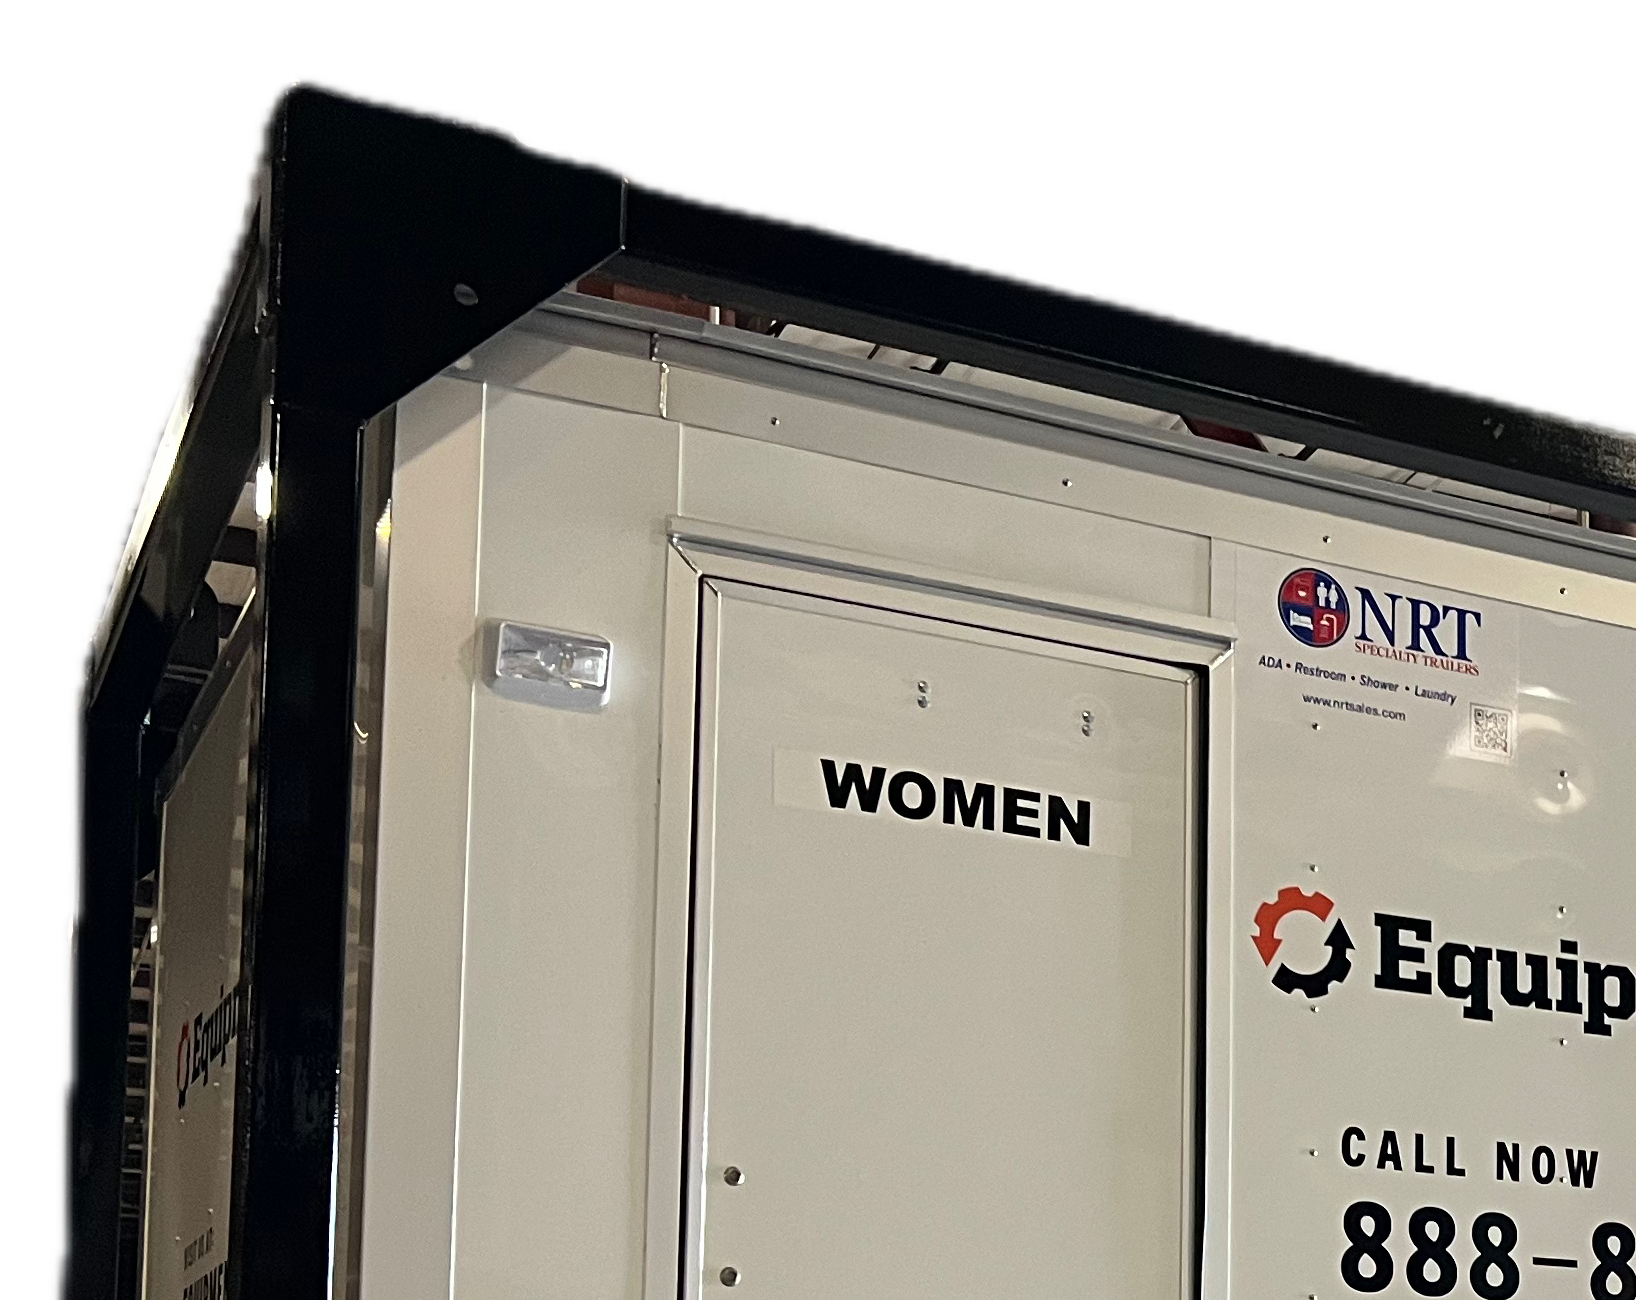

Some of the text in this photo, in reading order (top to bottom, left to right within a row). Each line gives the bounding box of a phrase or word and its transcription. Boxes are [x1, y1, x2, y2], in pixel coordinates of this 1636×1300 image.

[1354, 586, 1481, 663] NRT
[1258, 655, 1457, 706] ADA Restroom Shower Laundry
[1354, 641, 1480, 677] SPECIALTY TRAILERS
[1302, 693, 1406, 722] www.nrtsales.com
[821, 759, 1091, 847] WOMEN
[1341, 1126, 1599, 1189] CALL NOW
